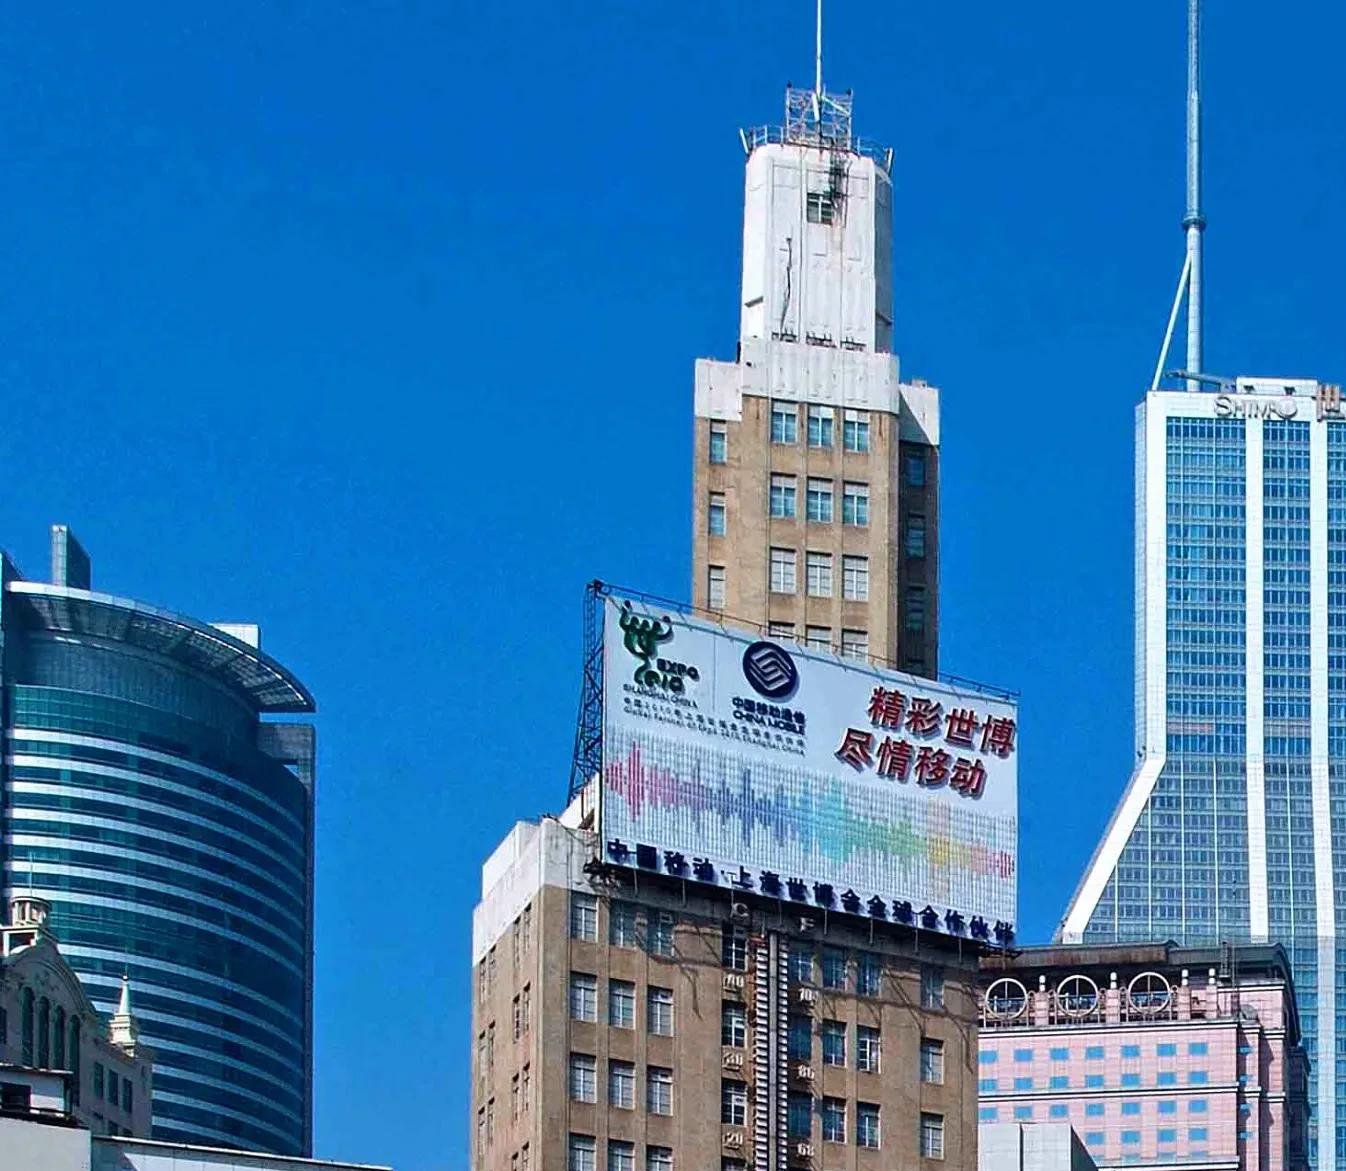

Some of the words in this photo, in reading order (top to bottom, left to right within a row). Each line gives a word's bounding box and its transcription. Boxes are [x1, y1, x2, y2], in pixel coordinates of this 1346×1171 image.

[656, 658, 700, 682] EXPO
[868, 686, 1016, 757] 精彩世博
[833, 727, 986, 797] 尽情移动
